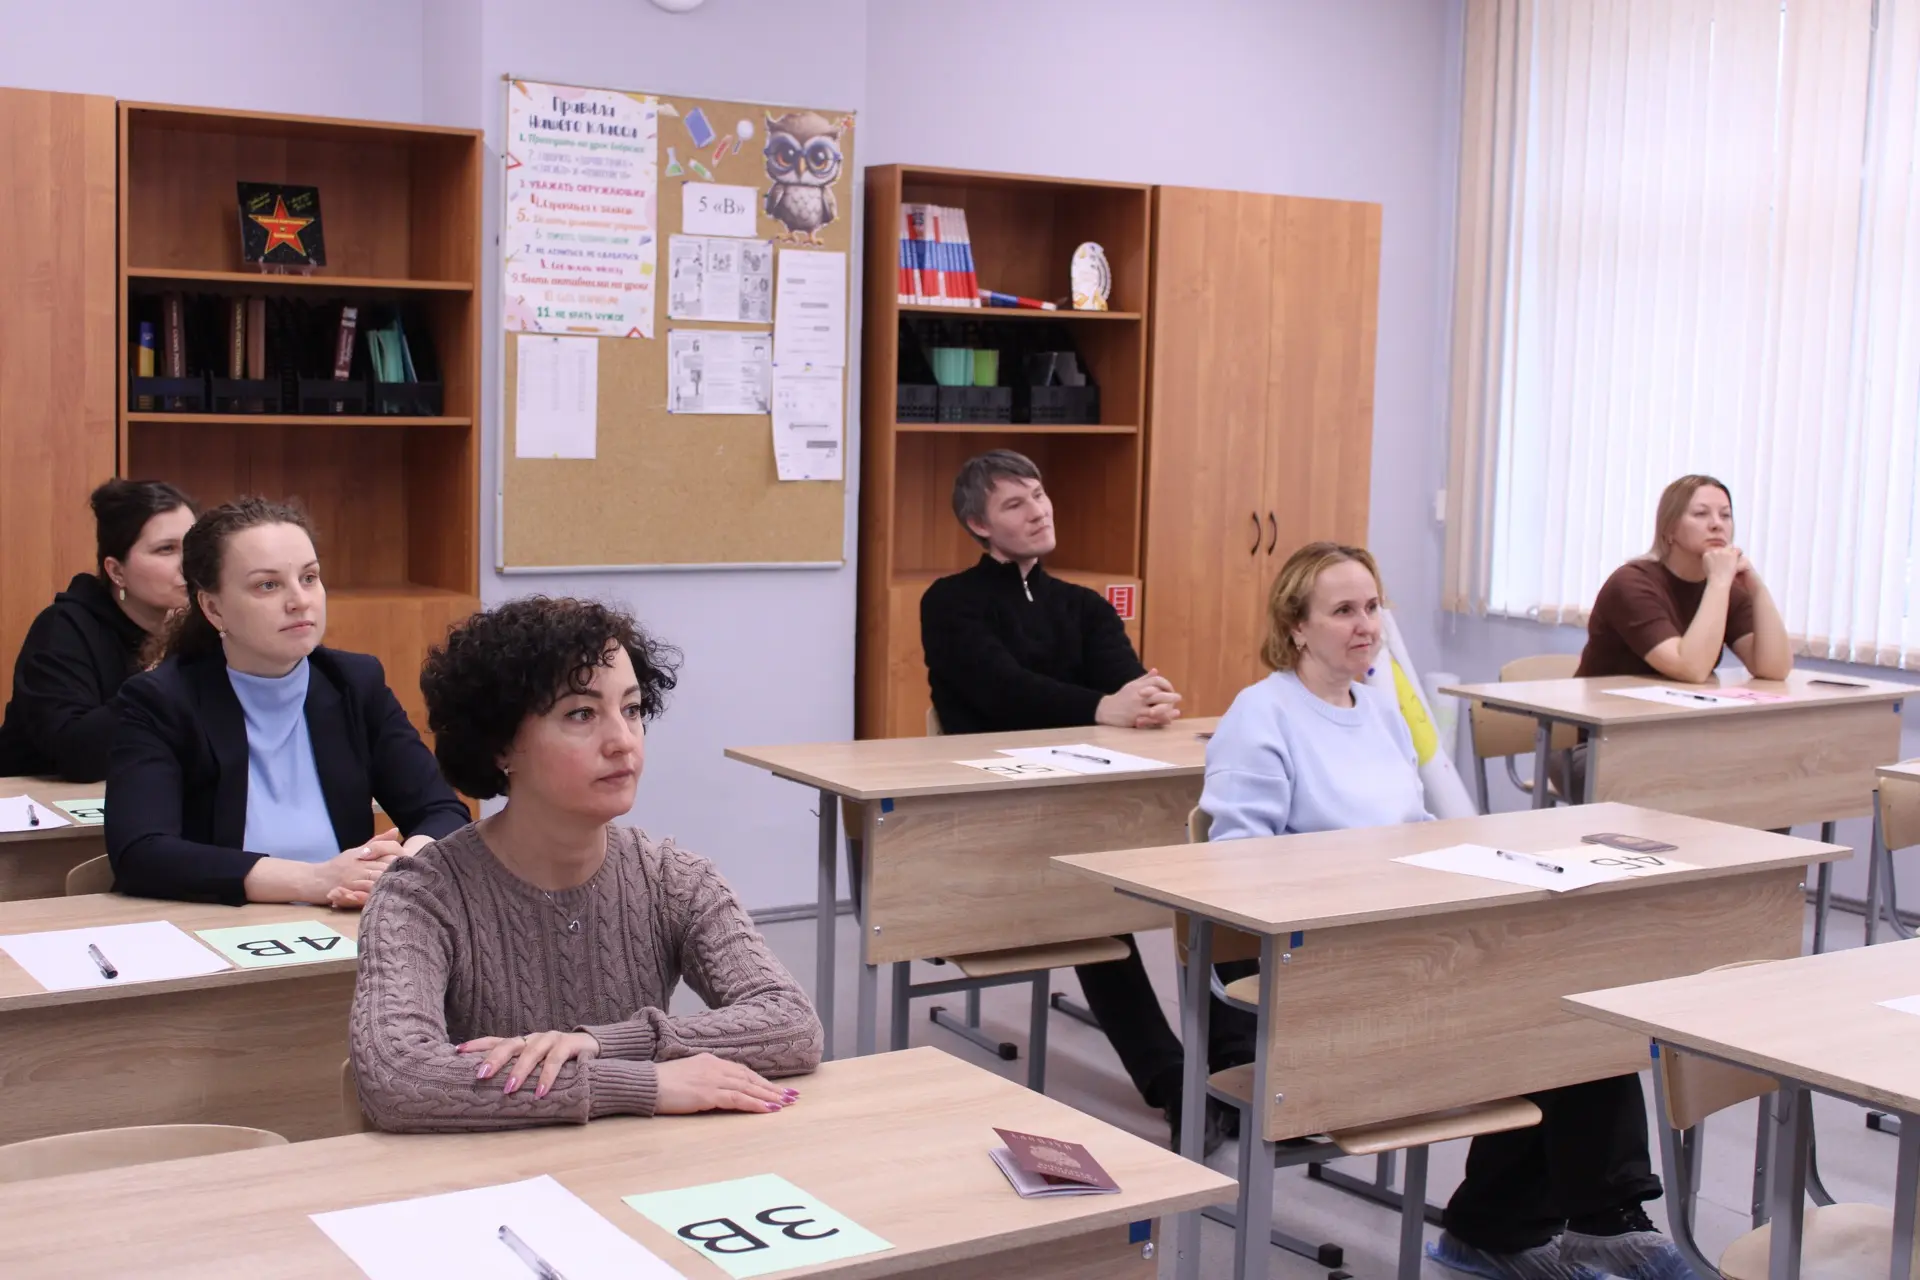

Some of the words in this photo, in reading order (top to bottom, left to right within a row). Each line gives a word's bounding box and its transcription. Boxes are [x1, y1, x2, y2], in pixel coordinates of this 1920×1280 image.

[553, 96, 615, 117] Правила
[530, 181, 573, 192] УВАЖАТЬ
[577, 184, 646, 198] ОКРУЖАЮЩИХ
[517, 208, 531, 222] 5.
[698, 196, 707, 212] 5
[713, 198, 746, 215] «В»
[555, 311, 565, 319] НЕ
[569, 311, 592, 320] БРАТЬ
[595, 313, 624, 322] ЧУЖОЕ
[237, 936, 342, 957] 4В
[677, 1205, 840, 1254] 3В
